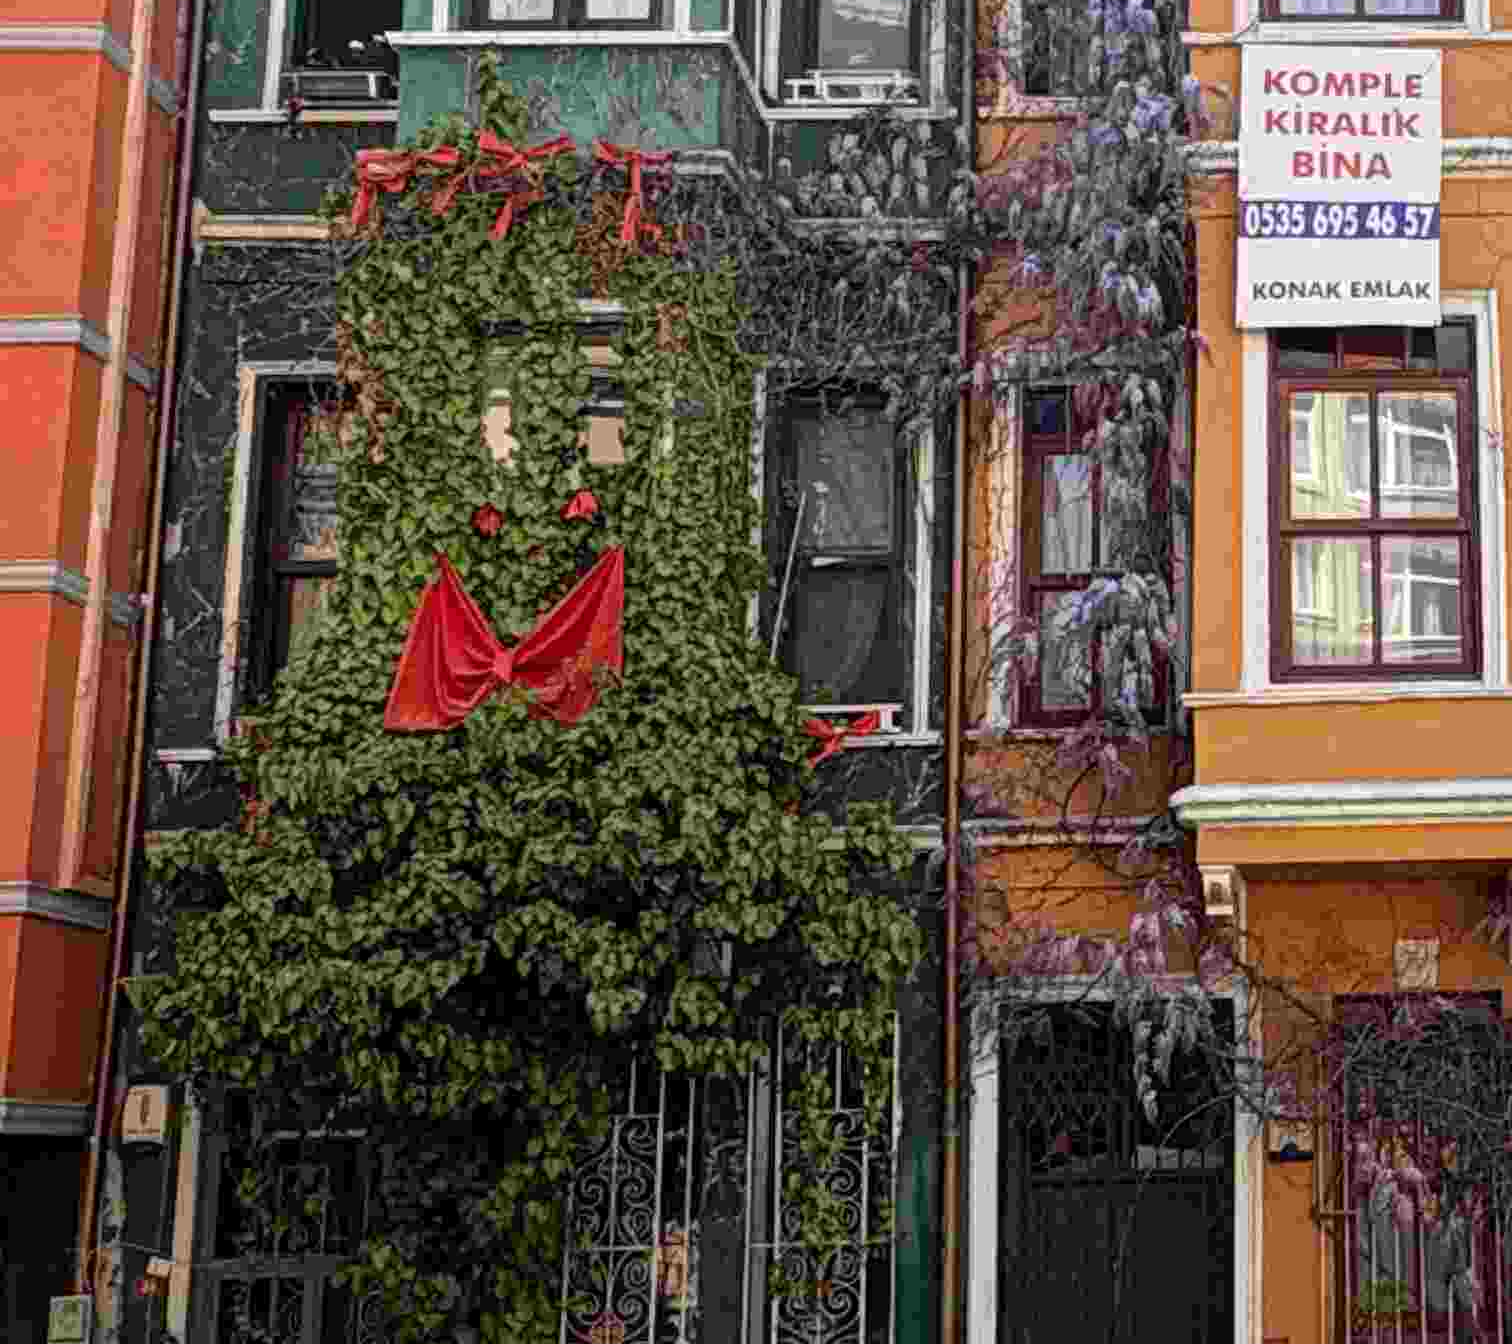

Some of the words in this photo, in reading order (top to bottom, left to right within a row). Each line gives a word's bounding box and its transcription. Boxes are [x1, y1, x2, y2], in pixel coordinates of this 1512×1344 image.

[1263, 69, 1425, 98] KOMPLE
[1263, 104, 1421, 138] KİRALIK
[1292, 143, 1392, 180] BİNA
[1247, 206, 1306, 236] 0535
[1313, 206, 1359, 236] 695
[1366, 207, 1396, 236] 46
[1403, 207, 1434, 236] 57
[1253, 281, 1342, 301] KONAK
[1350, 281, 1431, 300] EMLAK
